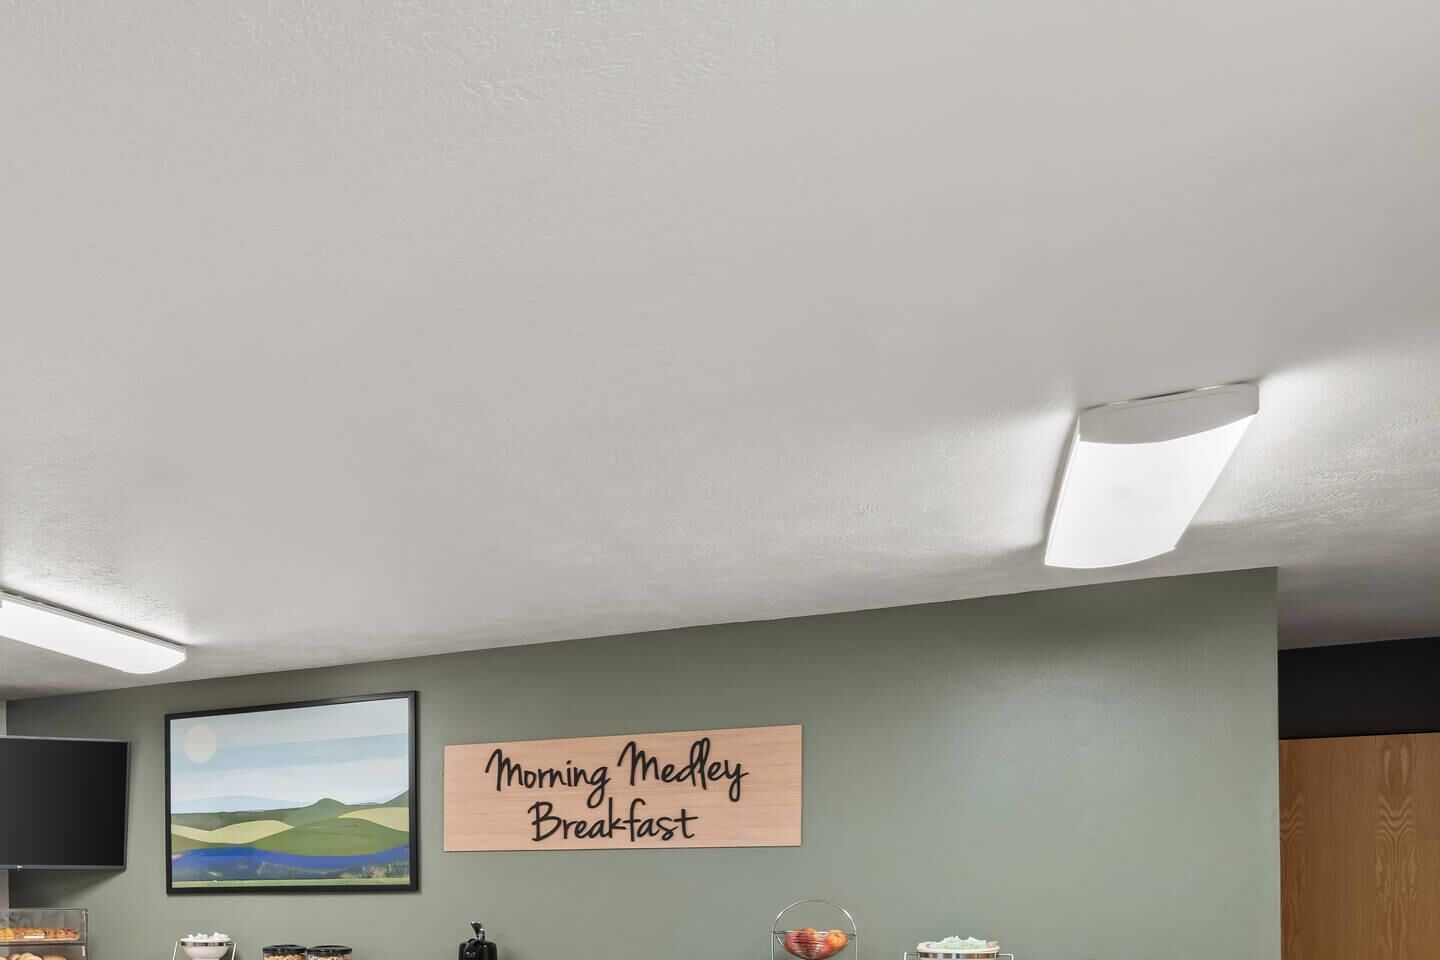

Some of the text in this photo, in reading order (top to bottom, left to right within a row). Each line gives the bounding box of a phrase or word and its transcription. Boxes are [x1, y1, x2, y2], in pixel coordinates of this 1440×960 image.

[485, 737, 749, 808] Morning Medley
[528, 797, 698, 842] Breakfast
